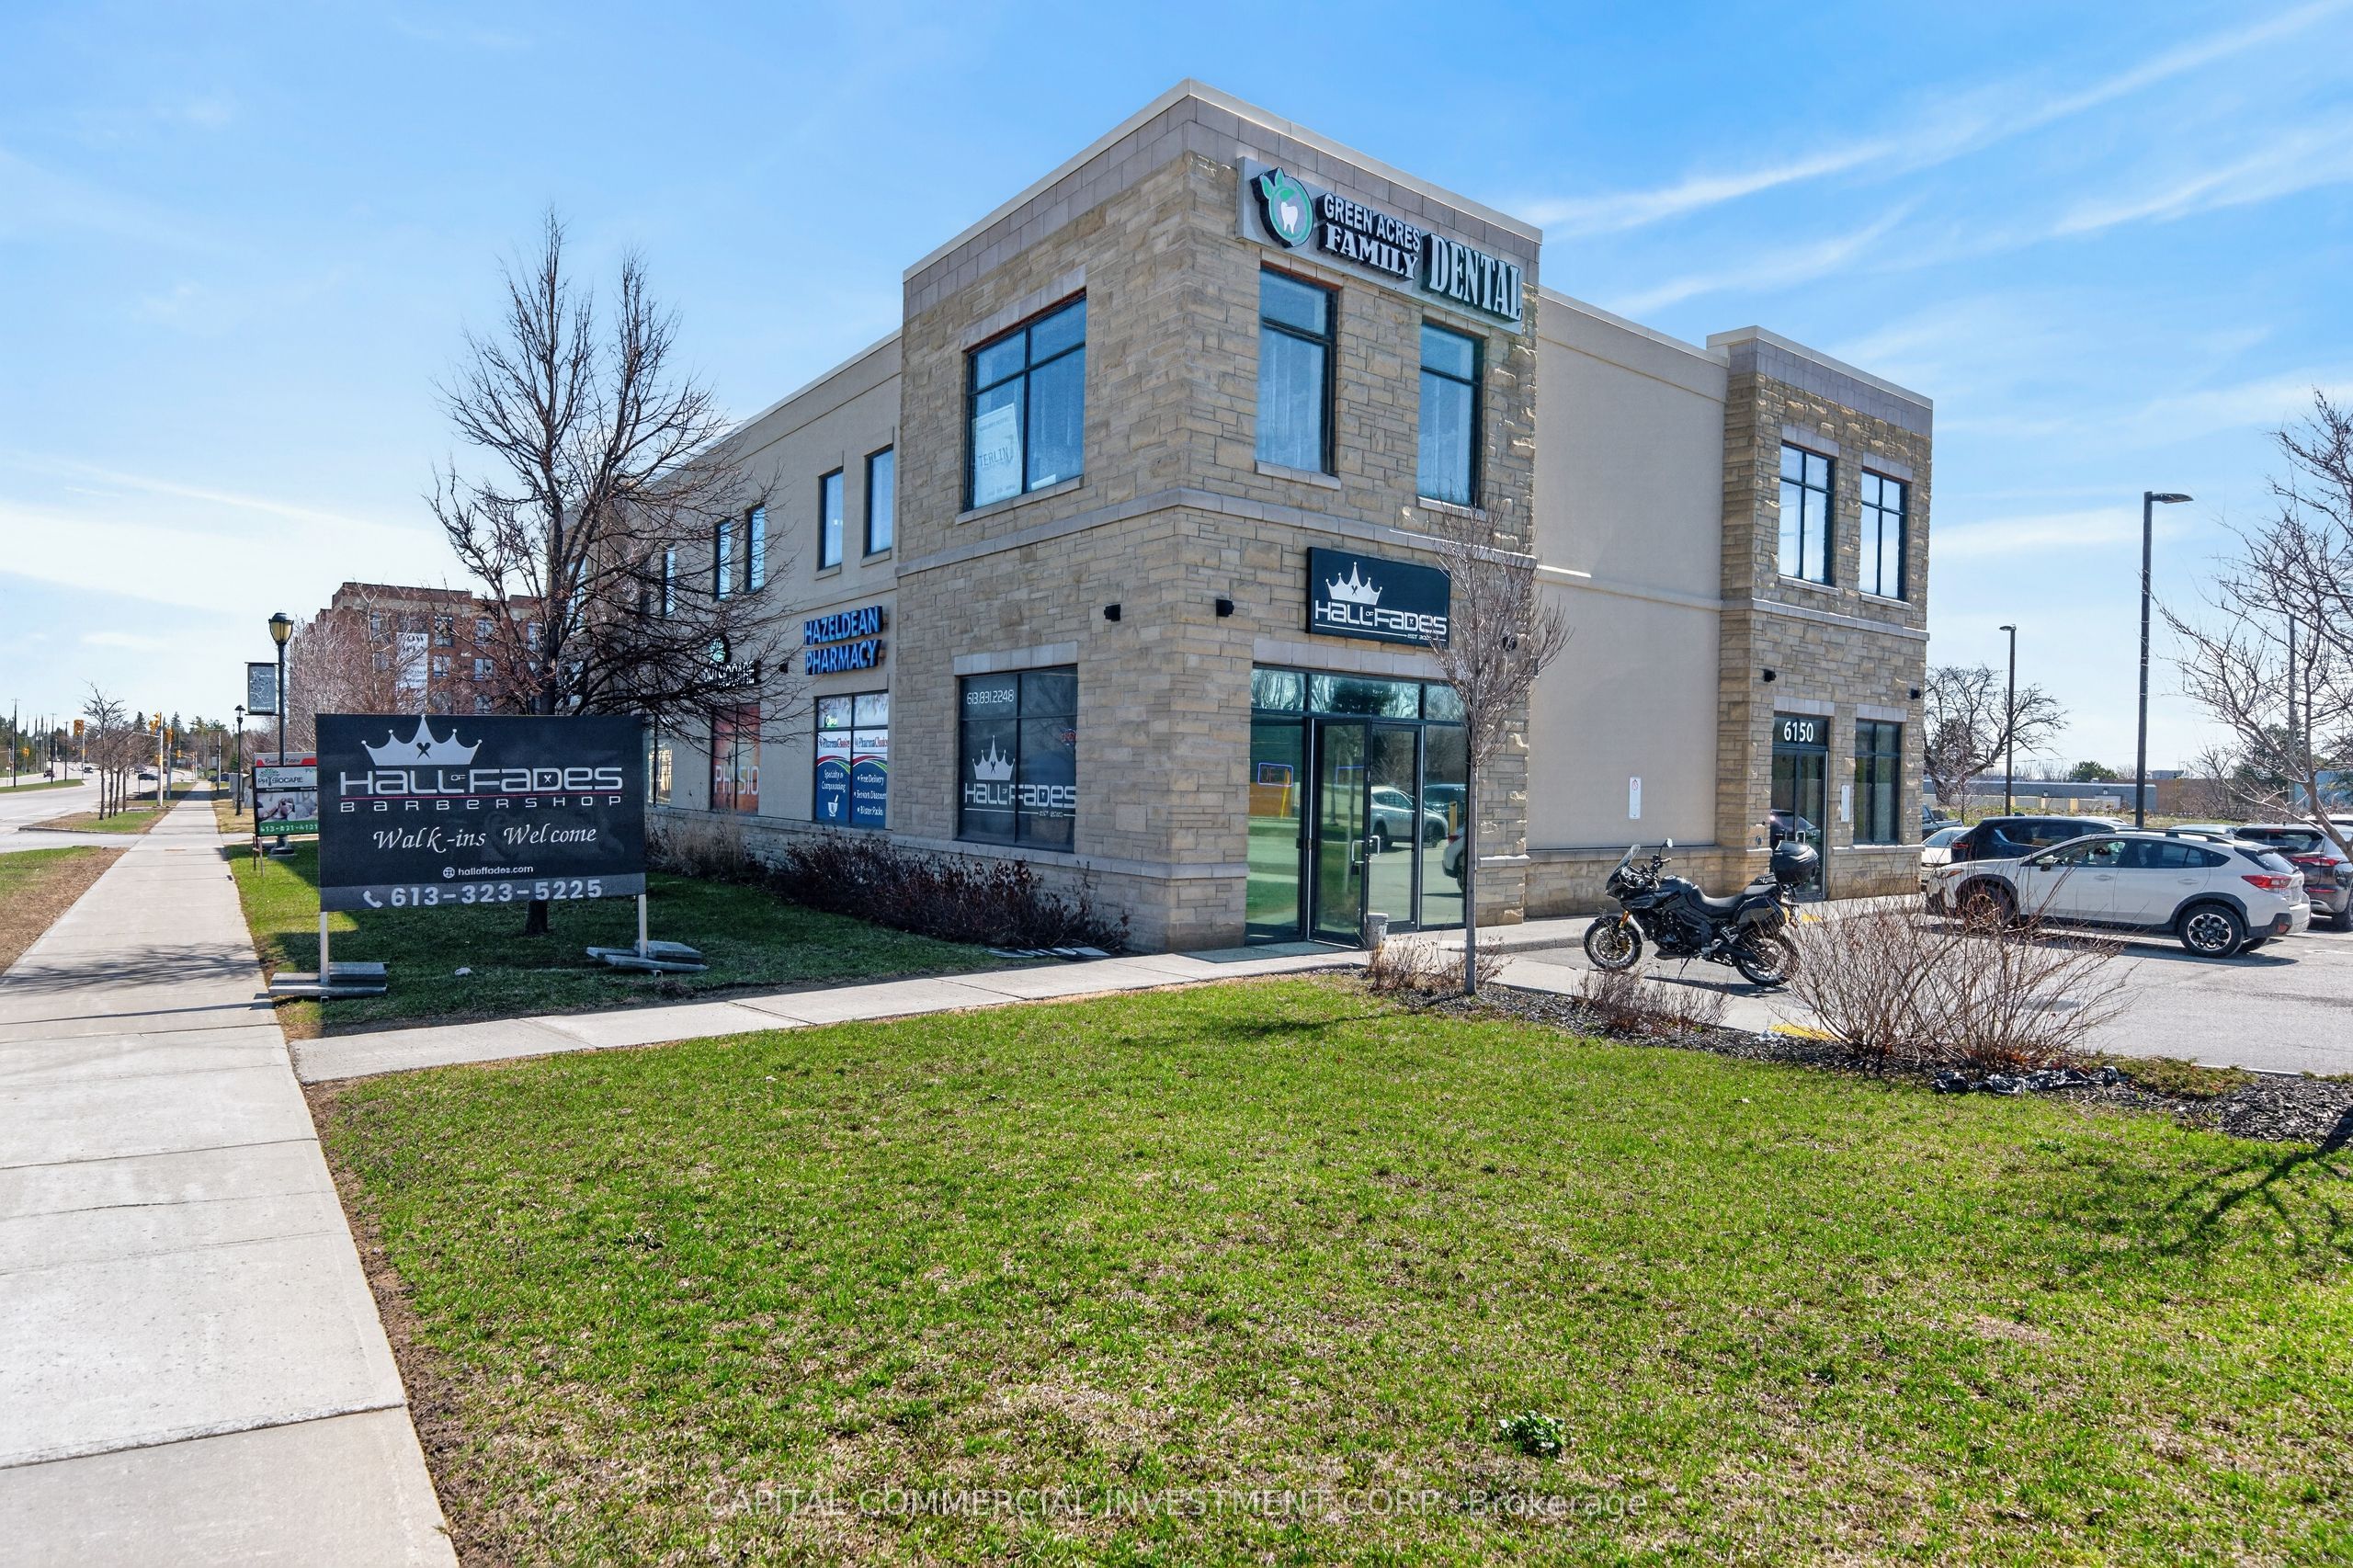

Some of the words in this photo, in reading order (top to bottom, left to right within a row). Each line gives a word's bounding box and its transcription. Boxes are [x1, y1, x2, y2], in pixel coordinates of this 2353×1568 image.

[1324, 192, 1375, 235] GREEN
[1376, 213, 1422, 253] ACRES
[1325, 222, 1419, 279] FAMILY
[1428, 233, 1523, 322] DENTAL
[804, 605, 881, 645] HAZELDEAN
[805, 640, 880, 676] PHARMACY
[967, 689, 1015, 705] 613.831.2248
[1783, 721, 1814, 743] 6150
[372, 826, 486, 854] Walk-ins
[503, 823, 597, 846] Welcome
[391, 879, 603, 907] 613-323-5225
